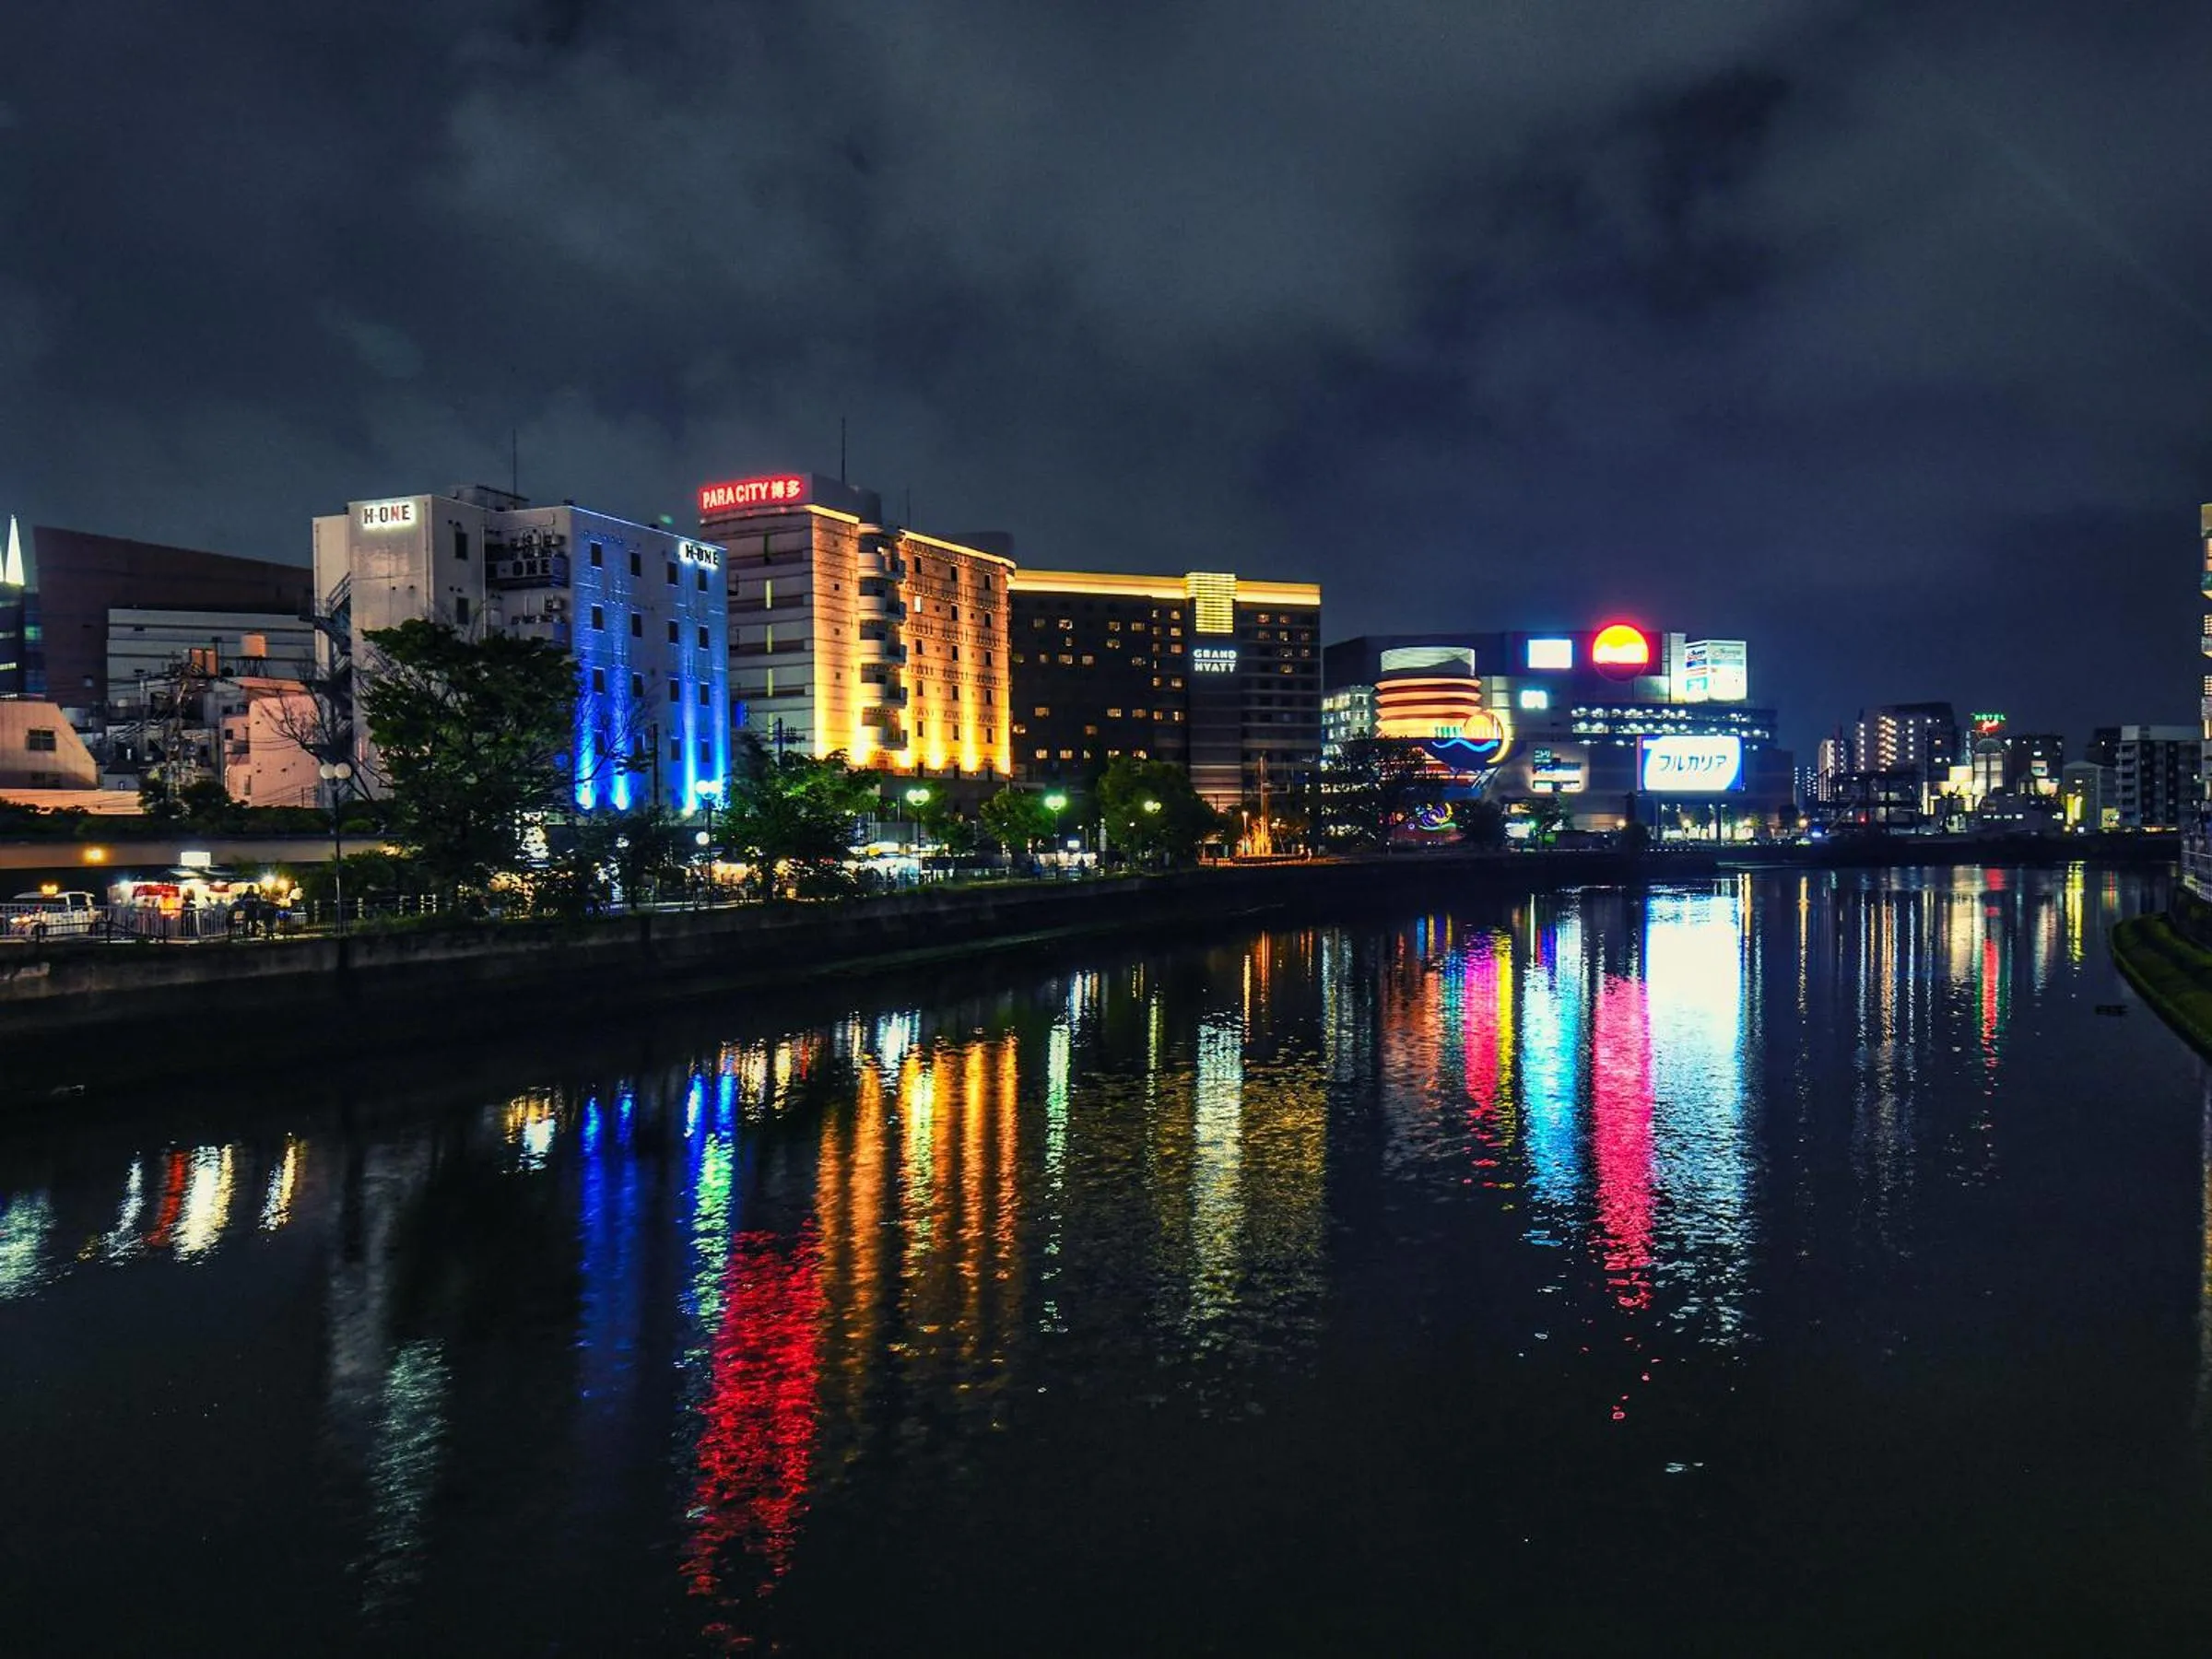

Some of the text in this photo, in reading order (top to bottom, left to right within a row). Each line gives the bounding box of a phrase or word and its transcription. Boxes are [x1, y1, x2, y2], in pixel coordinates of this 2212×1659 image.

[702, 481, 769, 510] PARACITY
[363, 504, 411, 524] H-ONE
[685, 544, 721, 566] H-ONE
[1193, 648, 1237, 660] GRAND
[1194, 663, 1236, 673] HYATT
